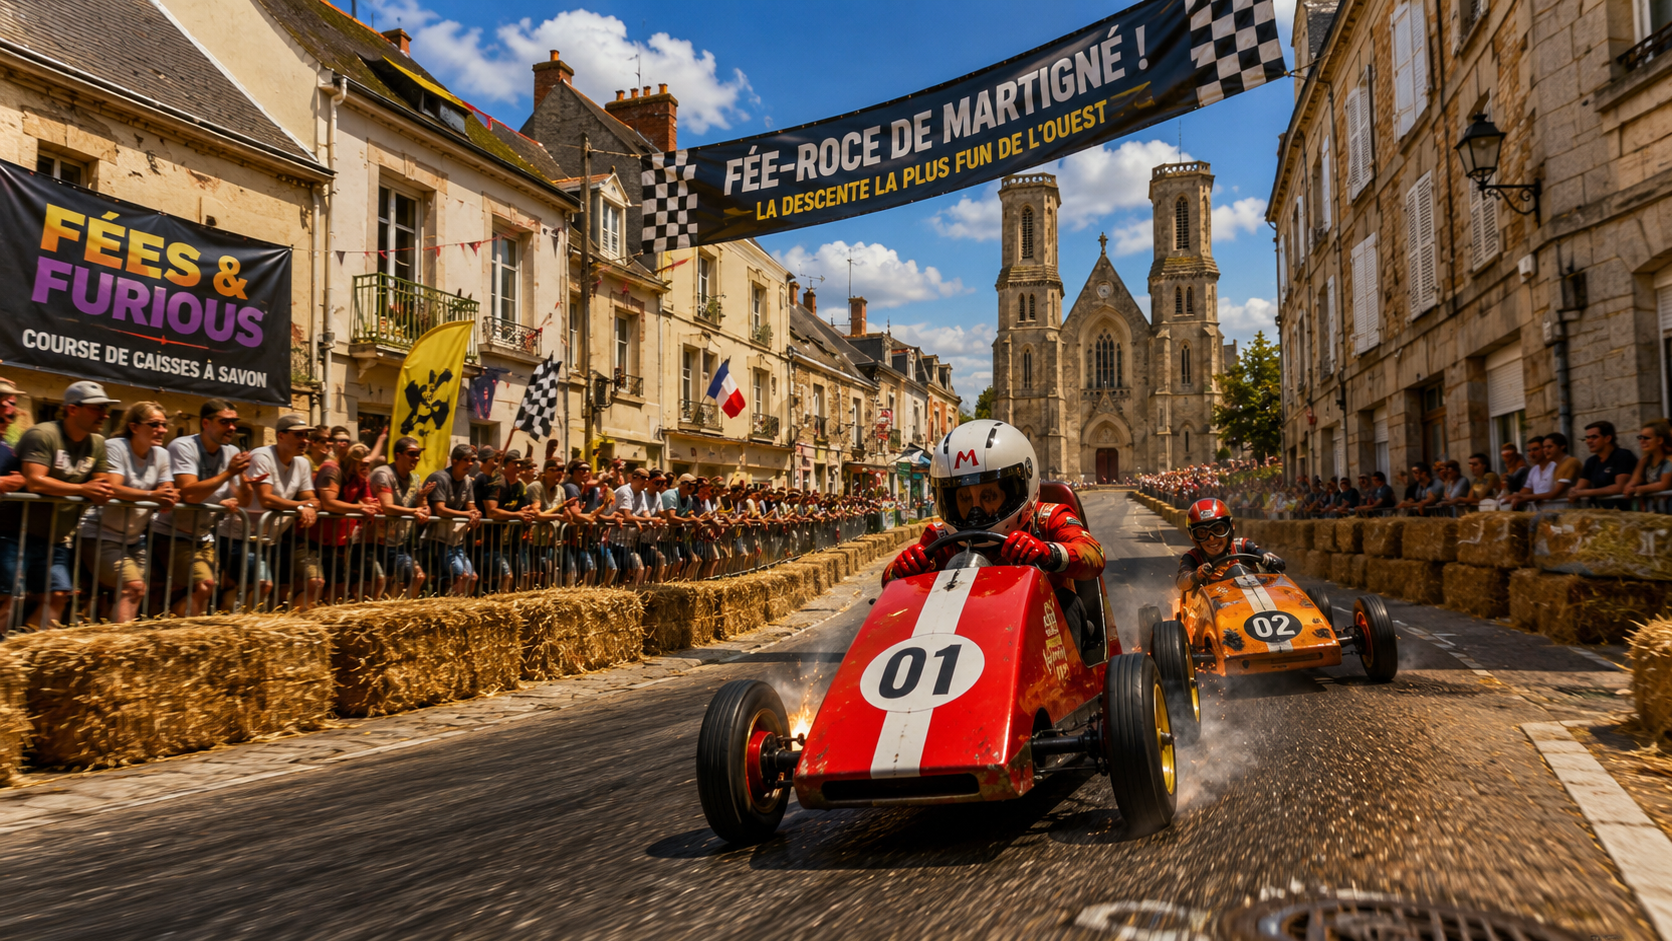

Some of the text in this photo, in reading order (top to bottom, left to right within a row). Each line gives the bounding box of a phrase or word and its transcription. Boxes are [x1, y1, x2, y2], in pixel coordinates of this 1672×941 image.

[724, 24, 1149, 197] FÉE-ROCE DE MARTIGNÉ !
[755, 99, 1107, 222] LA DESCENTE LA PLUS FUN DE L'OUEST
[40, 203, 249, 301] FÉES &
[31, 255, 265, 348] FURIOUS
[22, 328, 100, 361] COURSE
[105, 345, 129, 367] DE
[218, 366, 267, 389] SAVON
[954, 448, 980, 469] M
[1252, 613, 1297, 638] 02
[878, 643, 963, 699] 01
